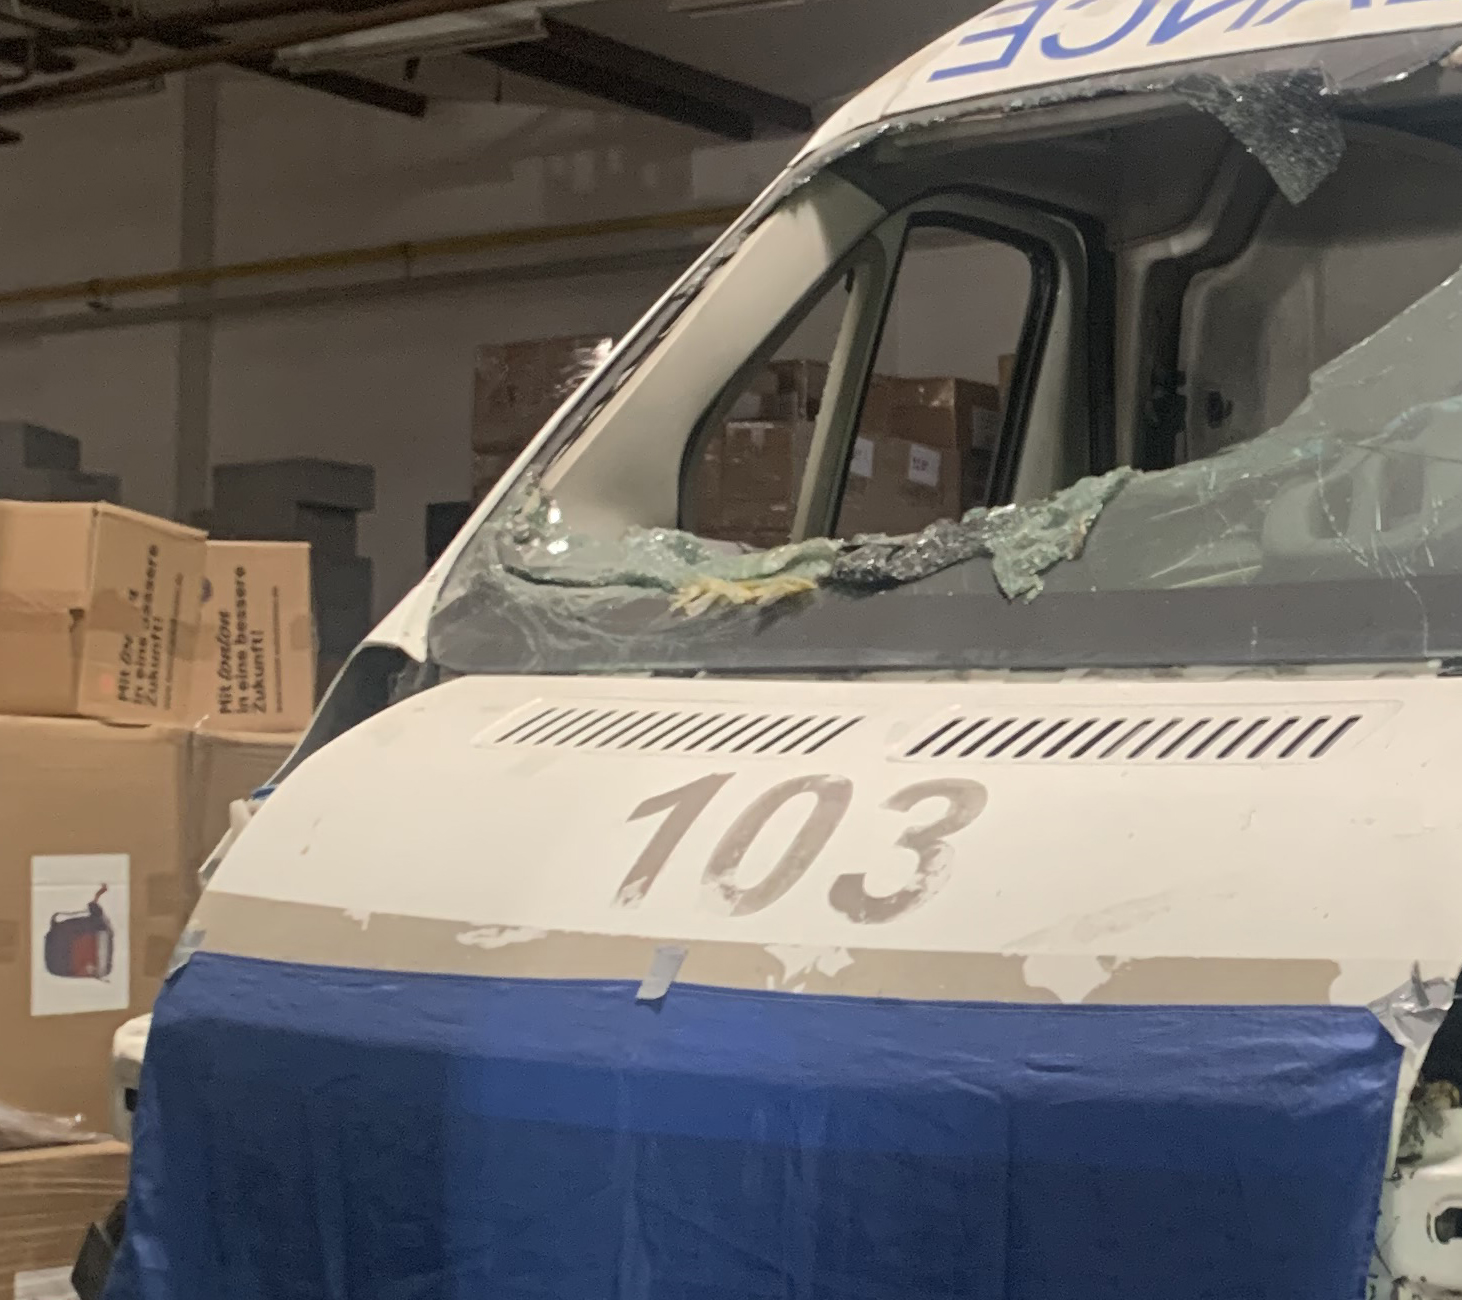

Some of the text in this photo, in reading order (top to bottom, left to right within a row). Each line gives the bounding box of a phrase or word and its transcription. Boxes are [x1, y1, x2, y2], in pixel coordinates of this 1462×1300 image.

[234, 567, 248, 713] in eine bessere
[251, 630, 267, 713] Zukunft!
[217, 685, 232, 714] Mit
[610, 772, 988, 924] 103
